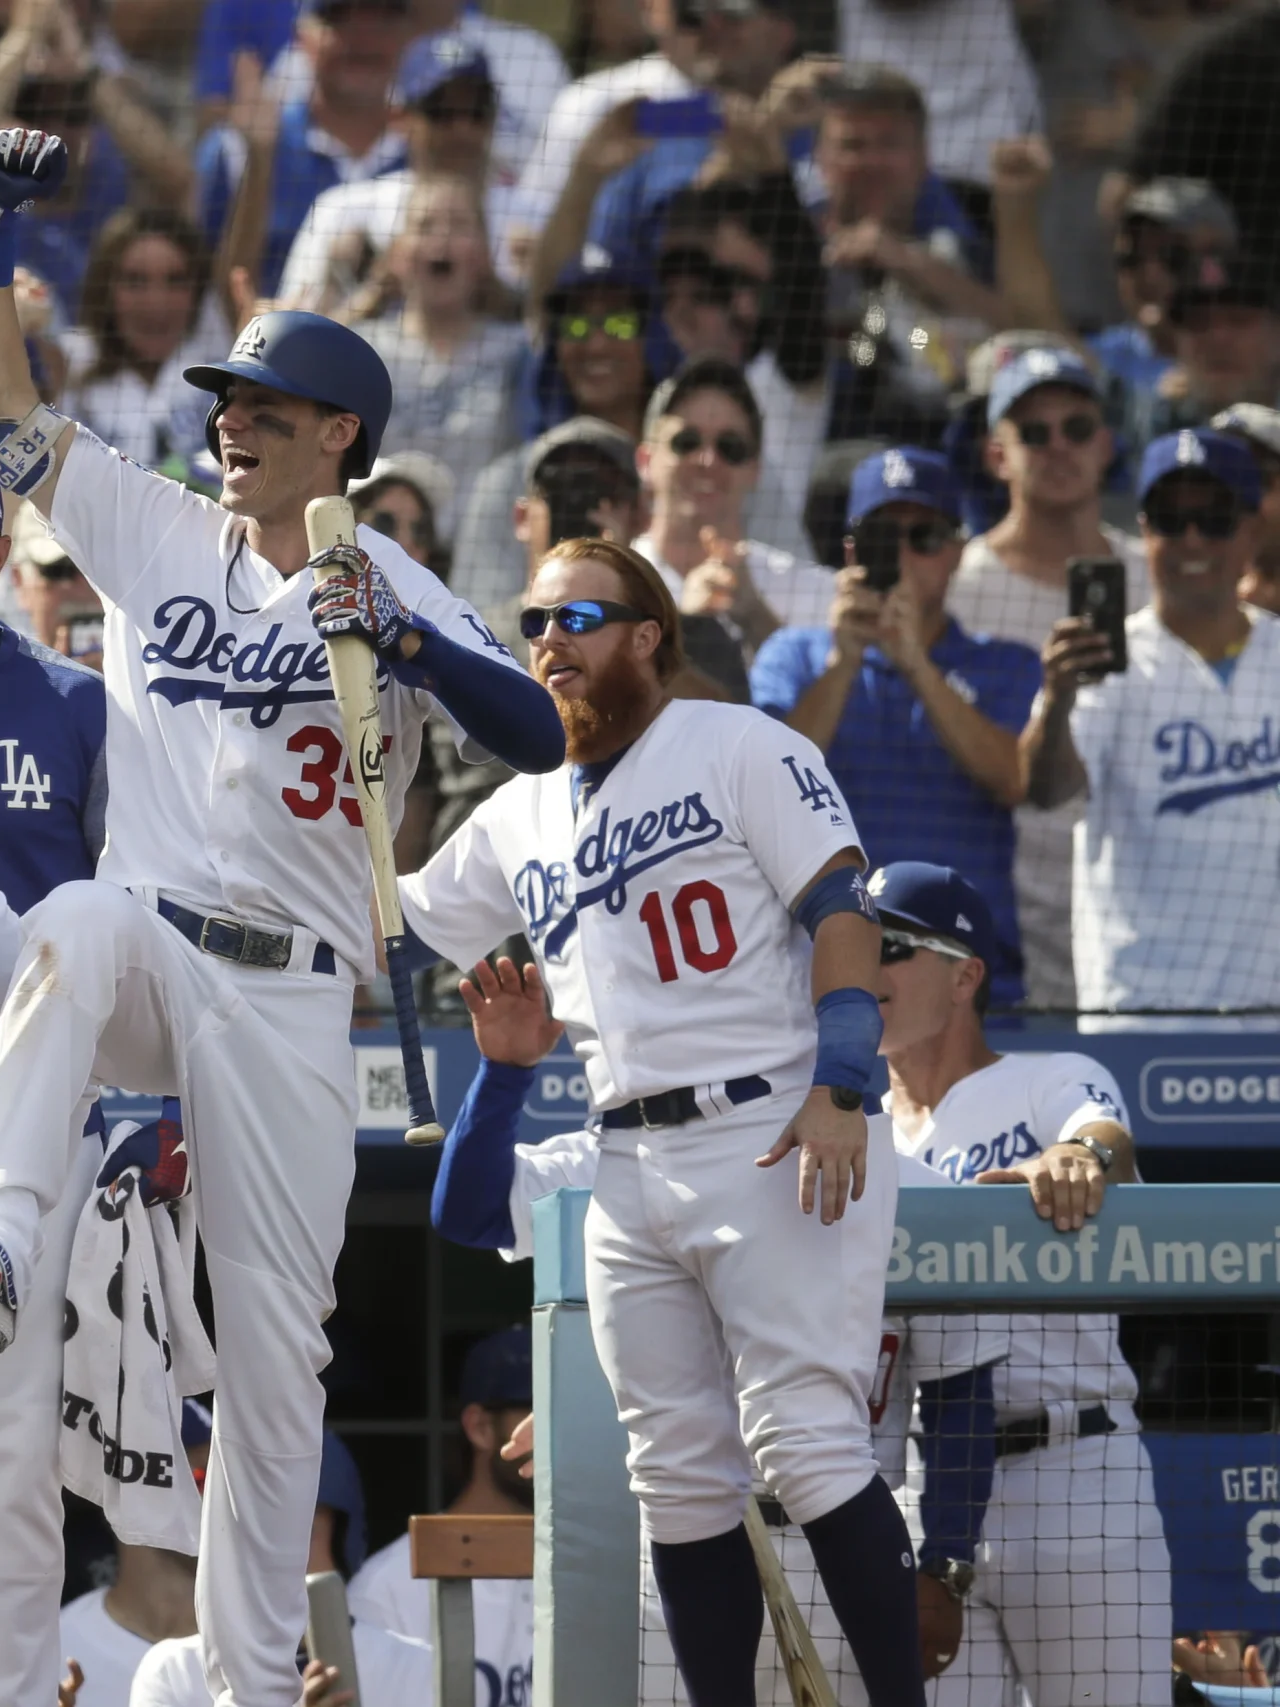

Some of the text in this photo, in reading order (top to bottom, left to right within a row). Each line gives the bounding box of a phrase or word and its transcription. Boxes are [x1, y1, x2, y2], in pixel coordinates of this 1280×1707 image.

[142, 595, 388, 729] Dodge
[0, 739, 50, 810] LA
[781, 756, 840, 812] LA
[514, 792, 723, 942] Dodgers
[639, 879, 738, 983] 10
[1162, 1076, 1280, 1103] DODGE
[885, 1226, 1028, 1283] Bank
[1037, 1225, 1098, 1282] of
[1222, 1466, 1280, 1502] GER
[1246, 1510, 1280, 1592] 8
